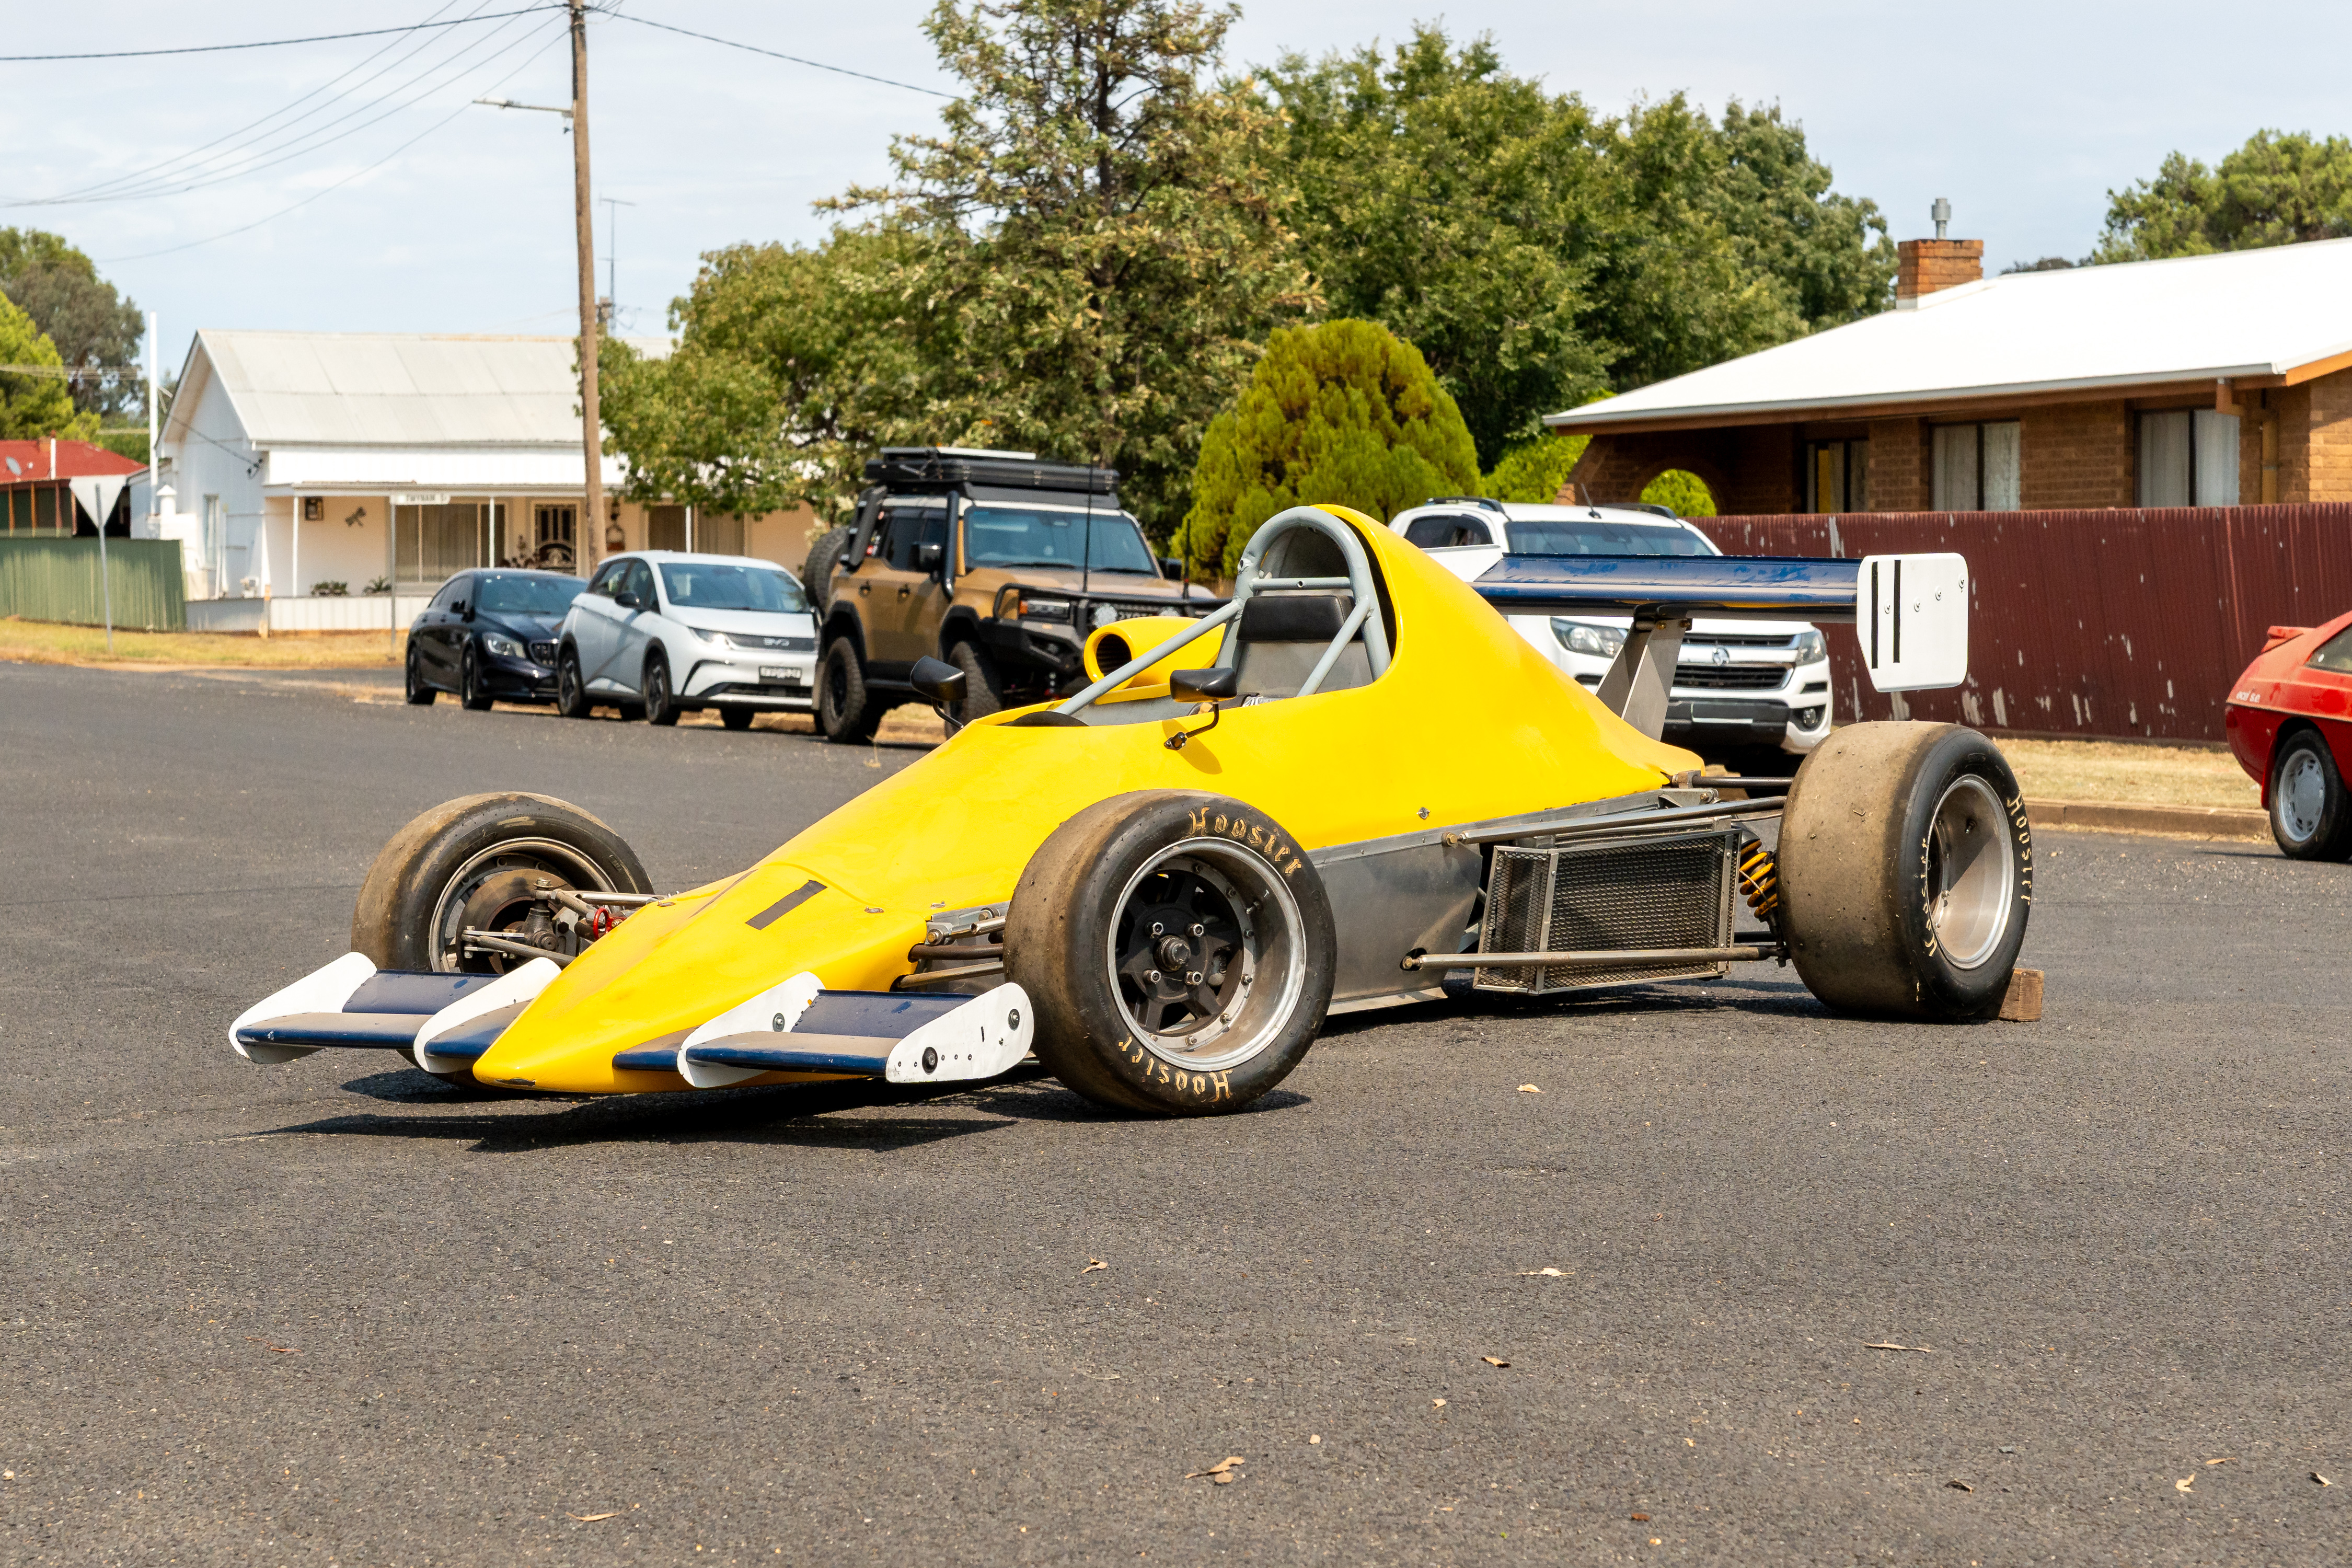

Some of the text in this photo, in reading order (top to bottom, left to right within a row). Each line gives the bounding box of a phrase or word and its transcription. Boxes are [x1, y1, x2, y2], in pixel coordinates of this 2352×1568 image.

[764, 637, 790, 646] BYD
[1186, 805, 1302, 874] Hoosier
[1119, 1035, 1233, 1103] Hoosier
